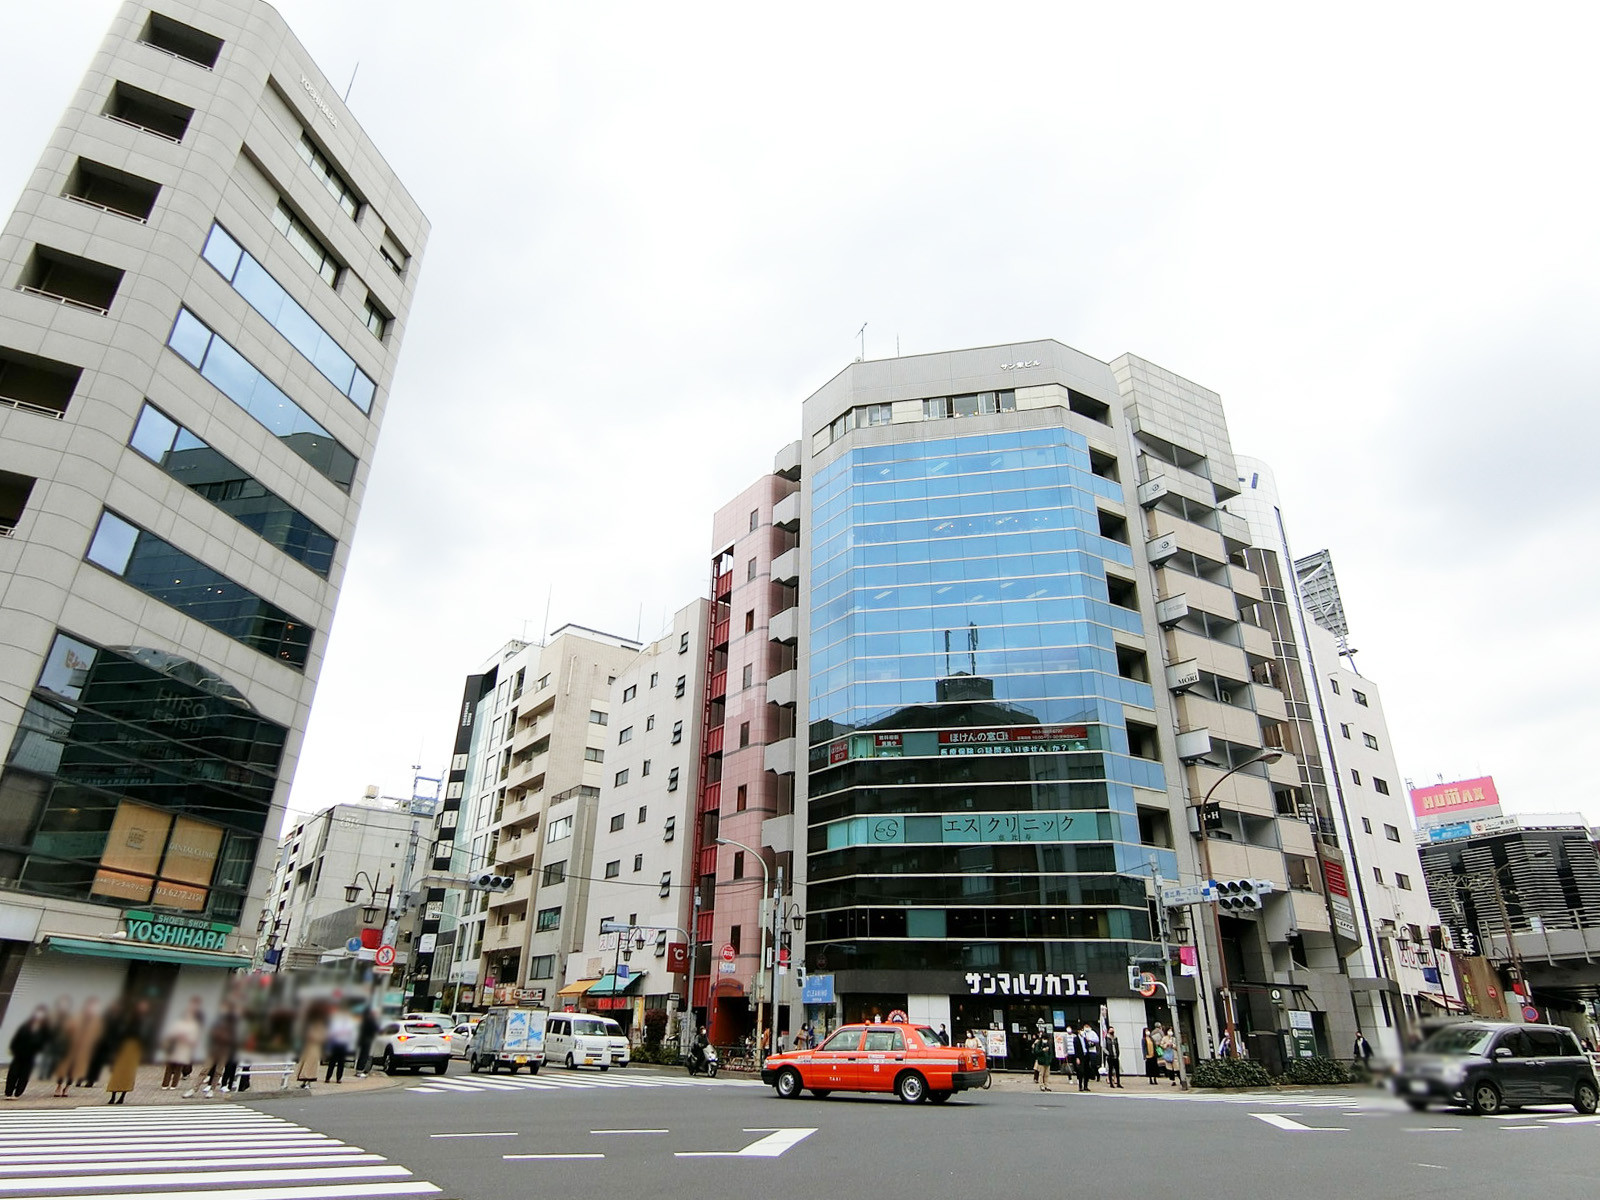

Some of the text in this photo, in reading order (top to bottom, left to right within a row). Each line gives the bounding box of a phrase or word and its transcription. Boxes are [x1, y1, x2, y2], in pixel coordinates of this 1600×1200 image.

[300, 75, 338, 129] YOSHIHARA
[156, 687, 207, 718] HIRO
[153, 708, 199, 734] EBISU
[1422, 786, 1486, 810] HUMAX
[944, 815, 1074, 833] エスクリニック
[158, 915, 209, 929] SHOES SHOP
[126, 920, 227, 950] YOSHIHARA
[965, 973, 1090, 995] サンマルクカフェ
